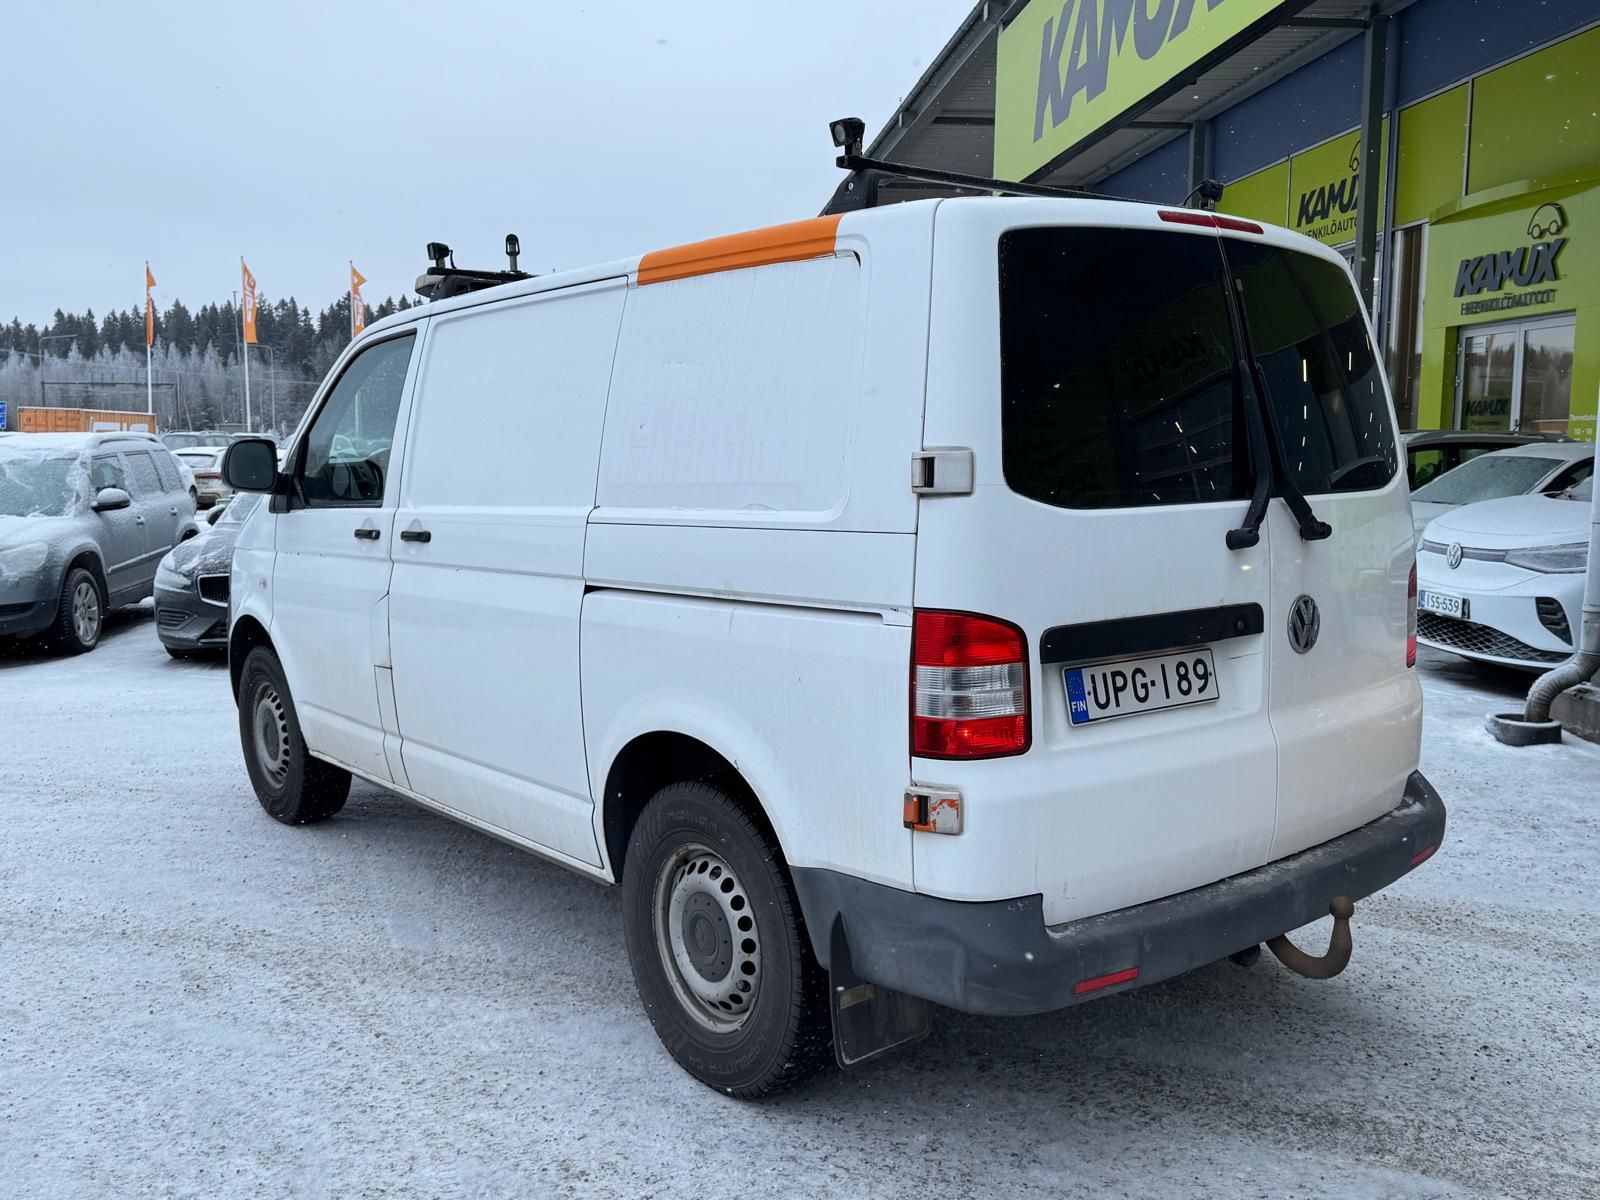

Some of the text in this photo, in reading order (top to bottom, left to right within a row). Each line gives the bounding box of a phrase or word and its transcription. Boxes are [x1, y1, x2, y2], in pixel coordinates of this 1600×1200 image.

[1033, 0, 1224, 143] KAMU
[1296, 174, 1360, 228] KAMU
[1453, 238, 1567, 297] KAMUX
[1072, 700, 1087, 713] FIN
[1090, 658, 1209, 710] UPG-189
